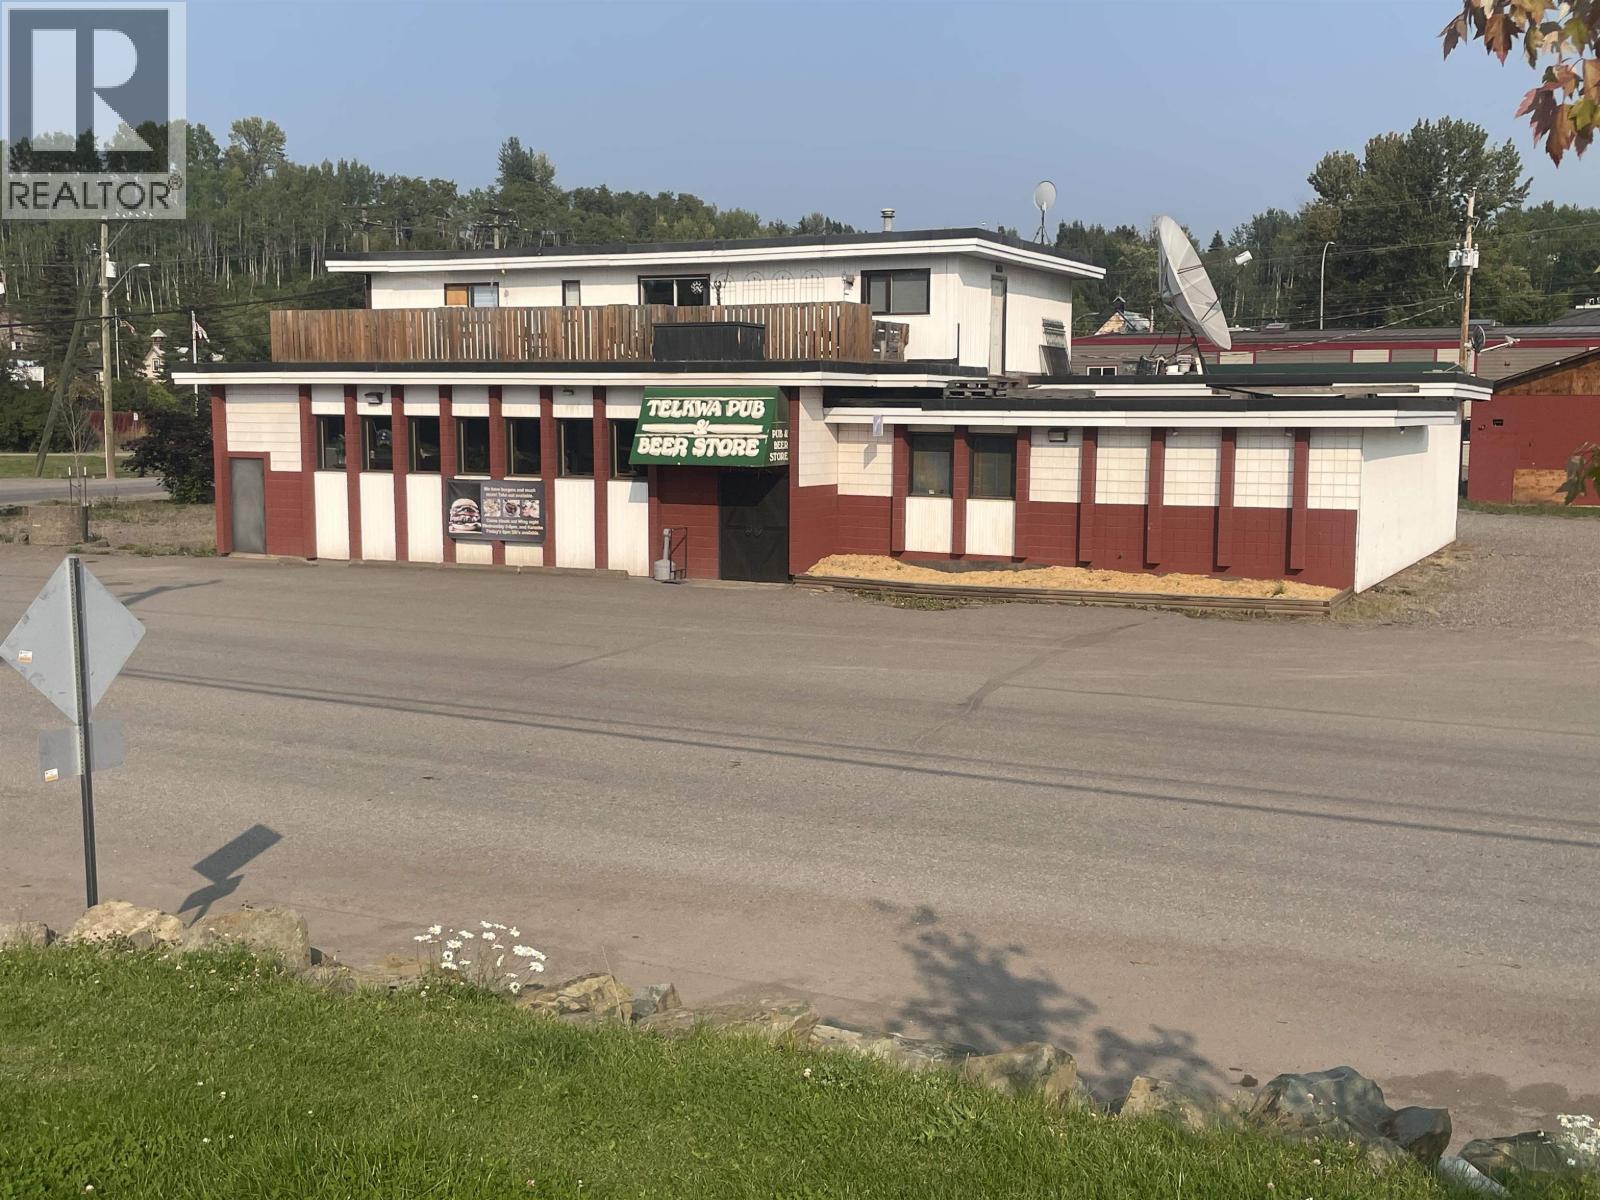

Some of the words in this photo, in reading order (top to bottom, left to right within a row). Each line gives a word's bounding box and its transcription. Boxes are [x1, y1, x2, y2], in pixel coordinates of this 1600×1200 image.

[647, 399, 722, 418] TELKWA
[726, 400, 765, 419] PUB
[693, 418, 710, 435] &
[771, 429, 784, 439] PUB
[637, 437, 689, 457] BEER
[692, 438, 760, 457] STORE
[773, 440, 789, 450] BEER
[769, 451, 789, 462] STORE
